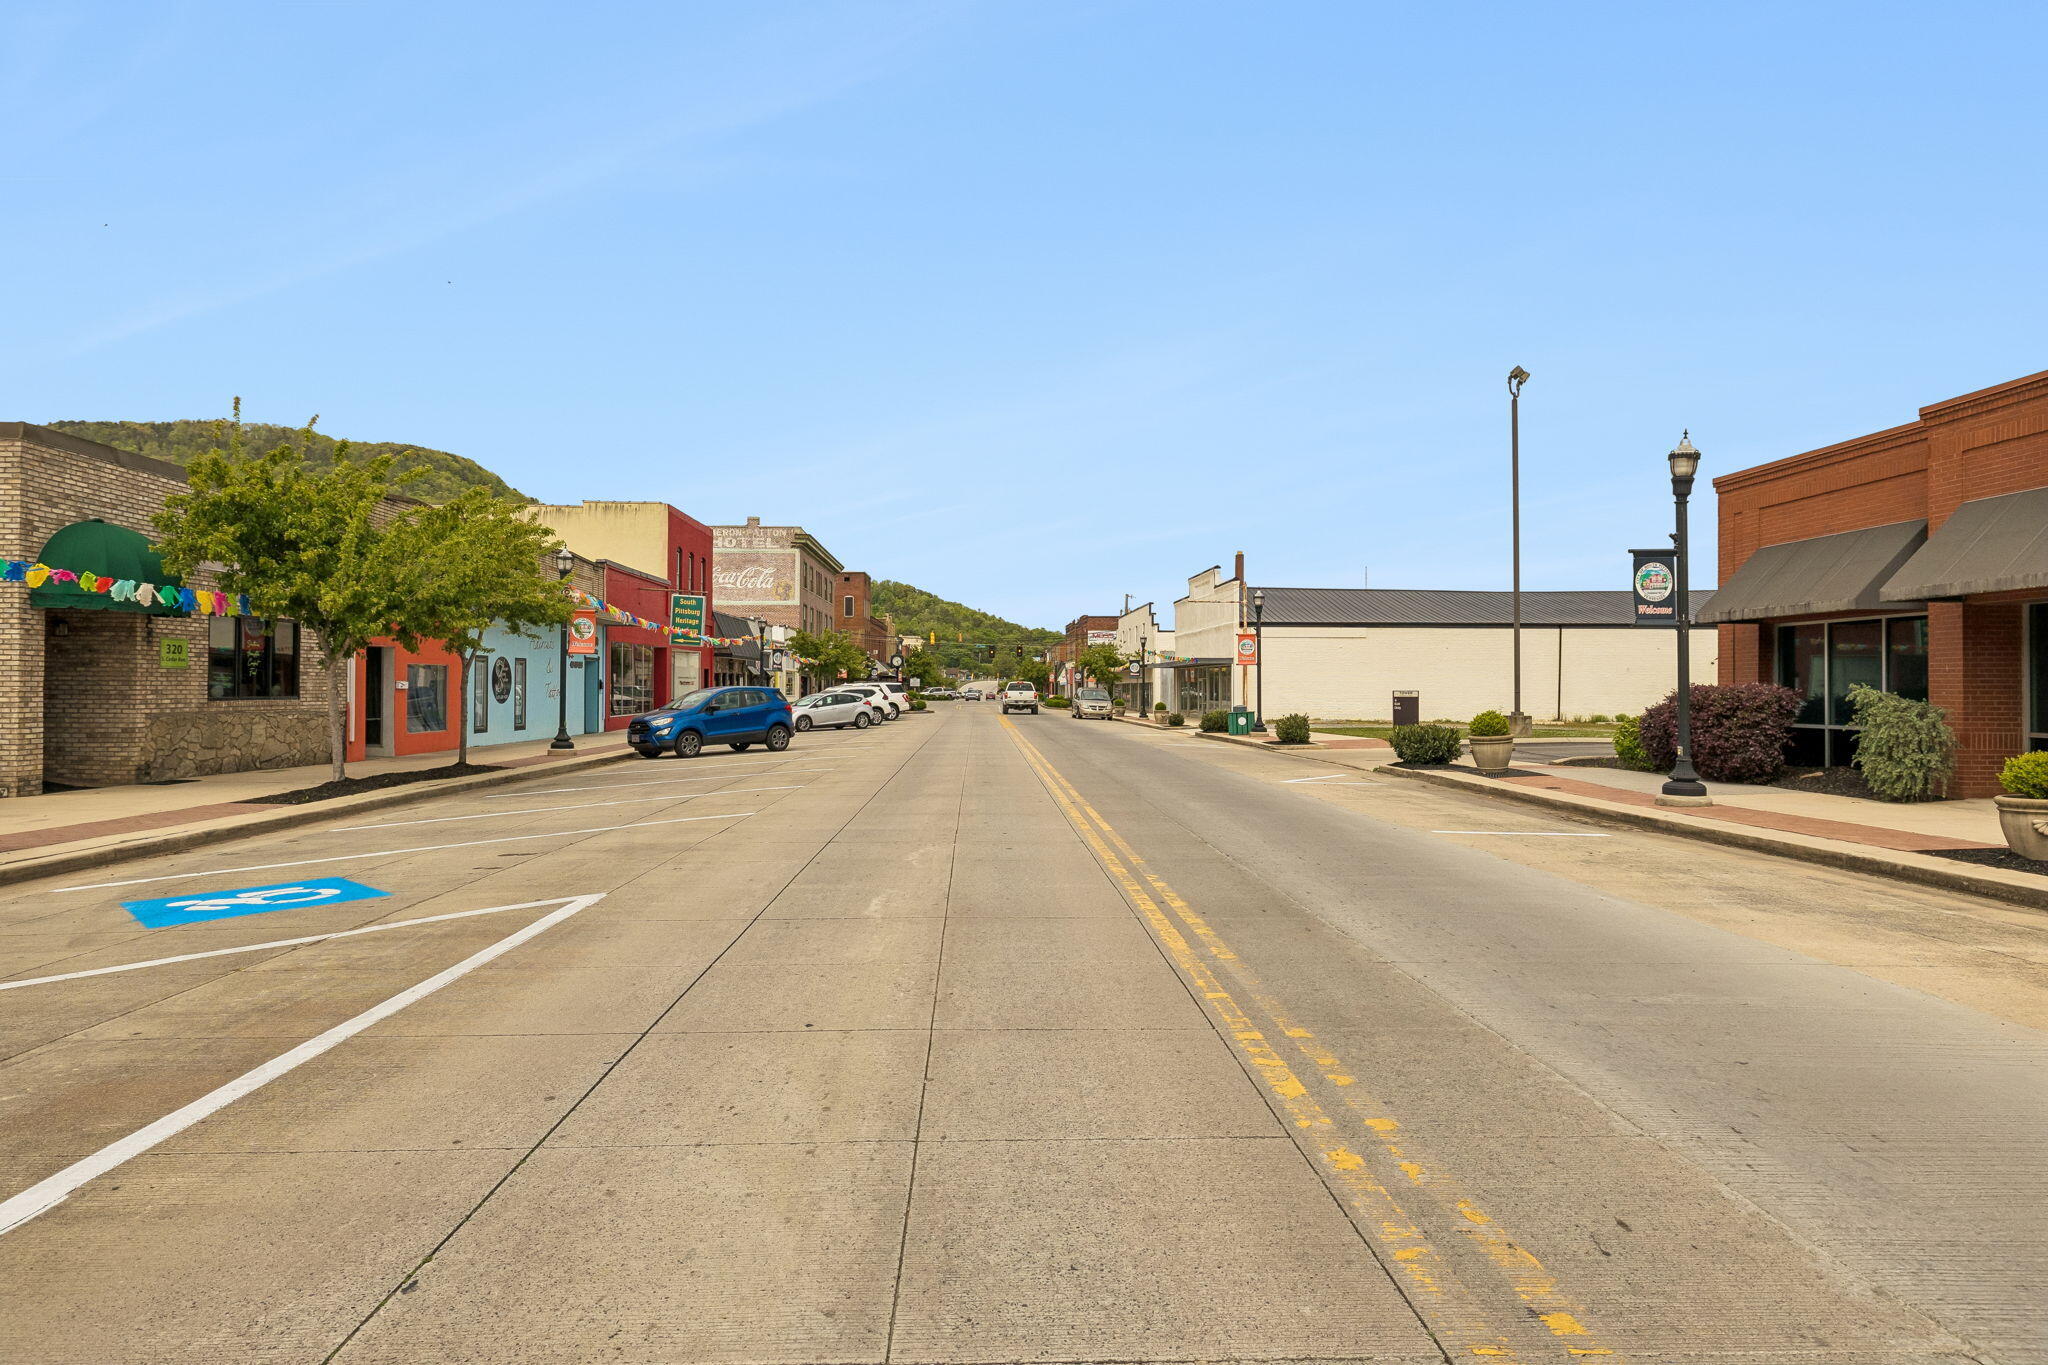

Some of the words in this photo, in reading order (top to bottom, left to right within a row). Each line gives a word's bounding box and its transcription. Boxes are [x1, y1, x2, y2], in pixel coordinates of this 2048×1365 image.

[679, 598, 697, 606] South
[674, 607, 701, 617] Pittsburg
[1638, 605, 1673, 614] Welcome
[675, 616, 700, 626] Heritage
[166, 644, 182, 654] 320
